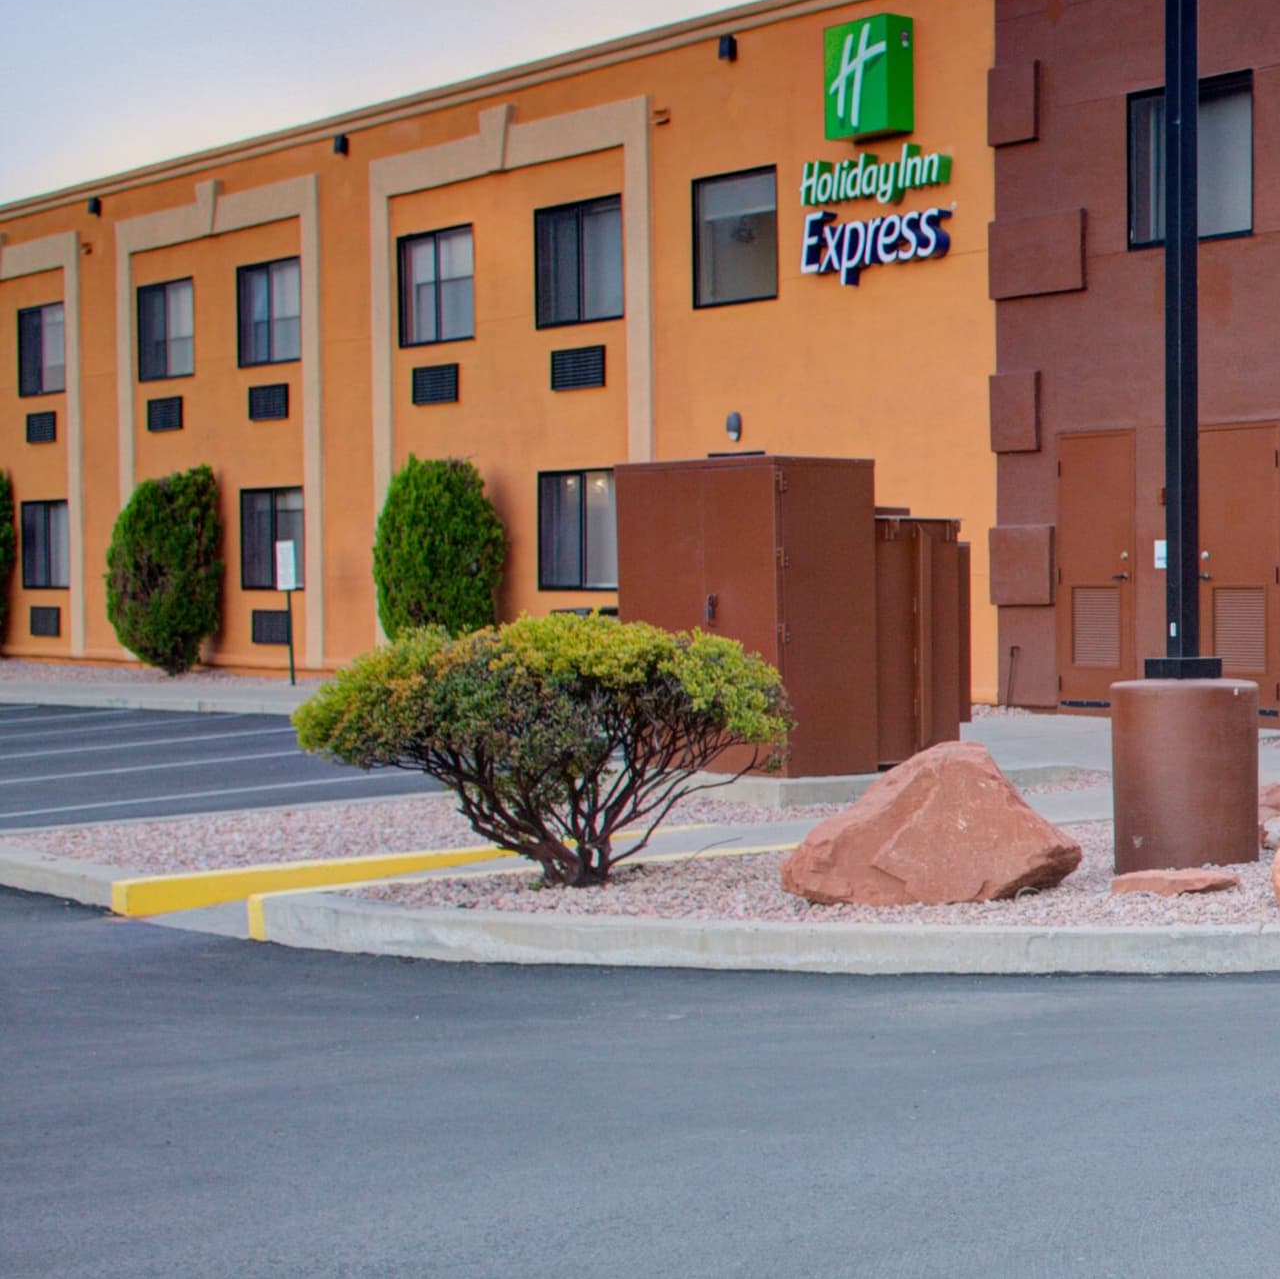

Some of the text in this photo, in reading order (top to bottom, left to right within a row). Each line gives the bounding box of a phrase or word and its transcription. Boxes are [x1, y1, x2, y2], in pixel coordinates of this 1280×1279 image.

[800, 142, 940, 207] Holiday Inn
[800, 207, 941, 286] Express
